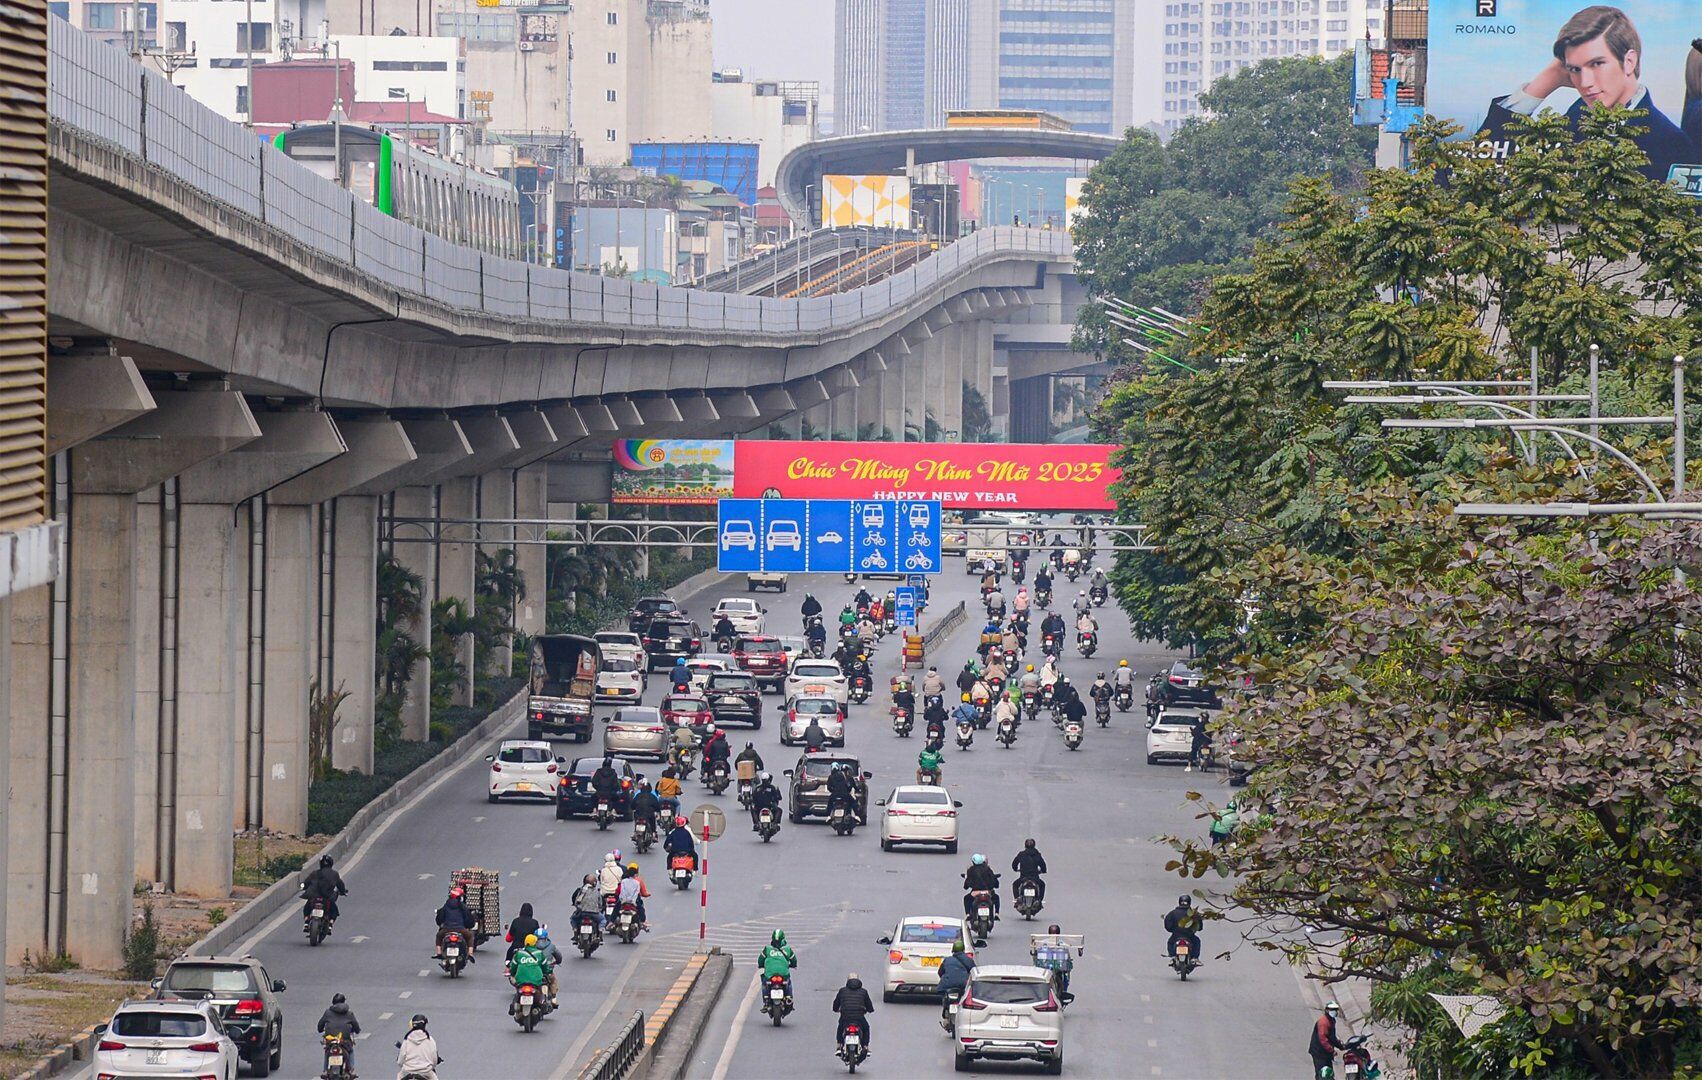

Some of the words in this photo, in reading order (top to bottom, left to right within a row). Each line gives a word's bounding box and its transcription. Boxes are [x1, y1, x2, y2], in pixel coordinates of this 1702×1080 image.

[1479, 0, 1494, 14] R
[1455, 24, 1516, 35] ROMANO
[787, 457, 837, 480] Chúc
[840, 458, 910, 489] Mừng
[914, 459, 973, 481] Năm
[976, 460, 1031, 482] Mới
[1036, 461, 1105, 483] 2023
[872, 490, 927, 500] HAPPY
[931, 491, 969, 502] NEW
[974, 491, 1018, 503] YEAR
